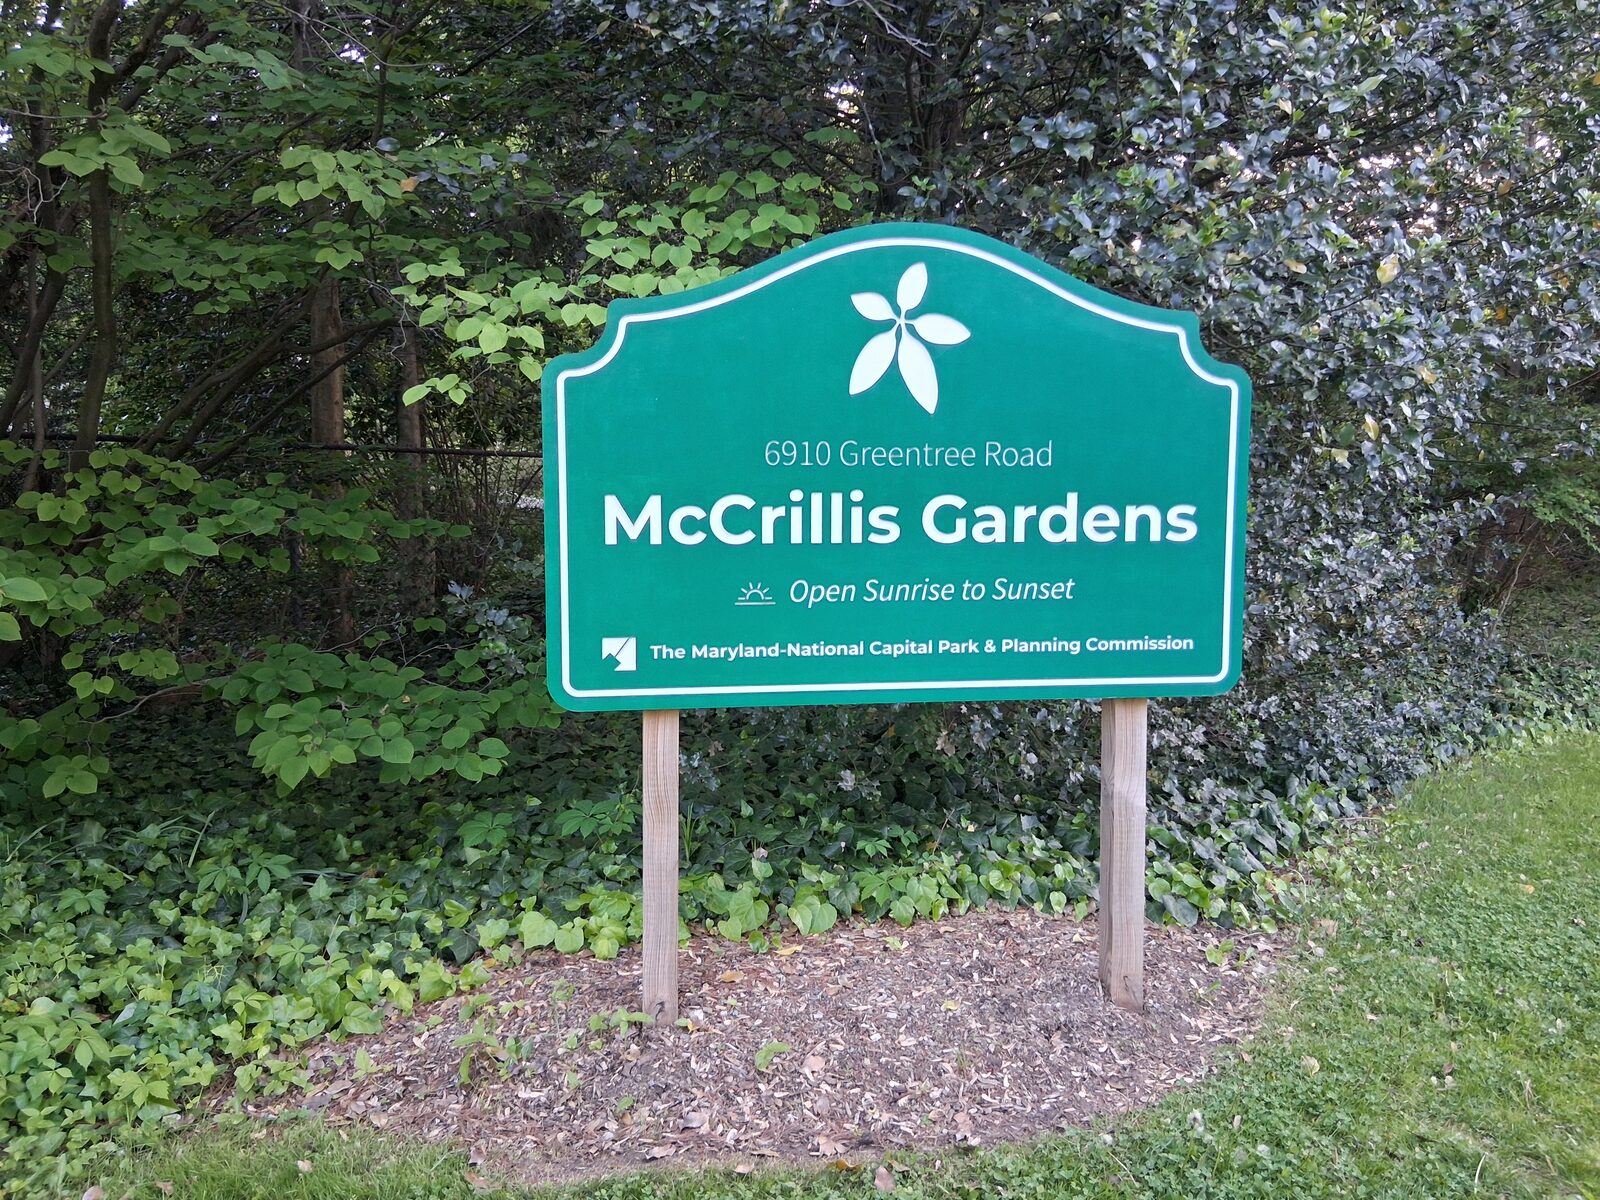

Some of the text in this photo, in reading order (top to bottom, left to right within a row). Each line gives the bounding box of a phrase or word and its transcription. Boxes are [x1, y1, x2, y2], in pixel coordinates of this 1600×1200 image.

[764, 440, 1052, 467] 6910 Greentree Road
[604, 489, 1198, 545] McCrillis Gardens
[790, 578, 1076, 608] Open Sunrise to Sunset
[650, 635, 1194, 662] The Maryland-National Capital Park & Planning Commission
